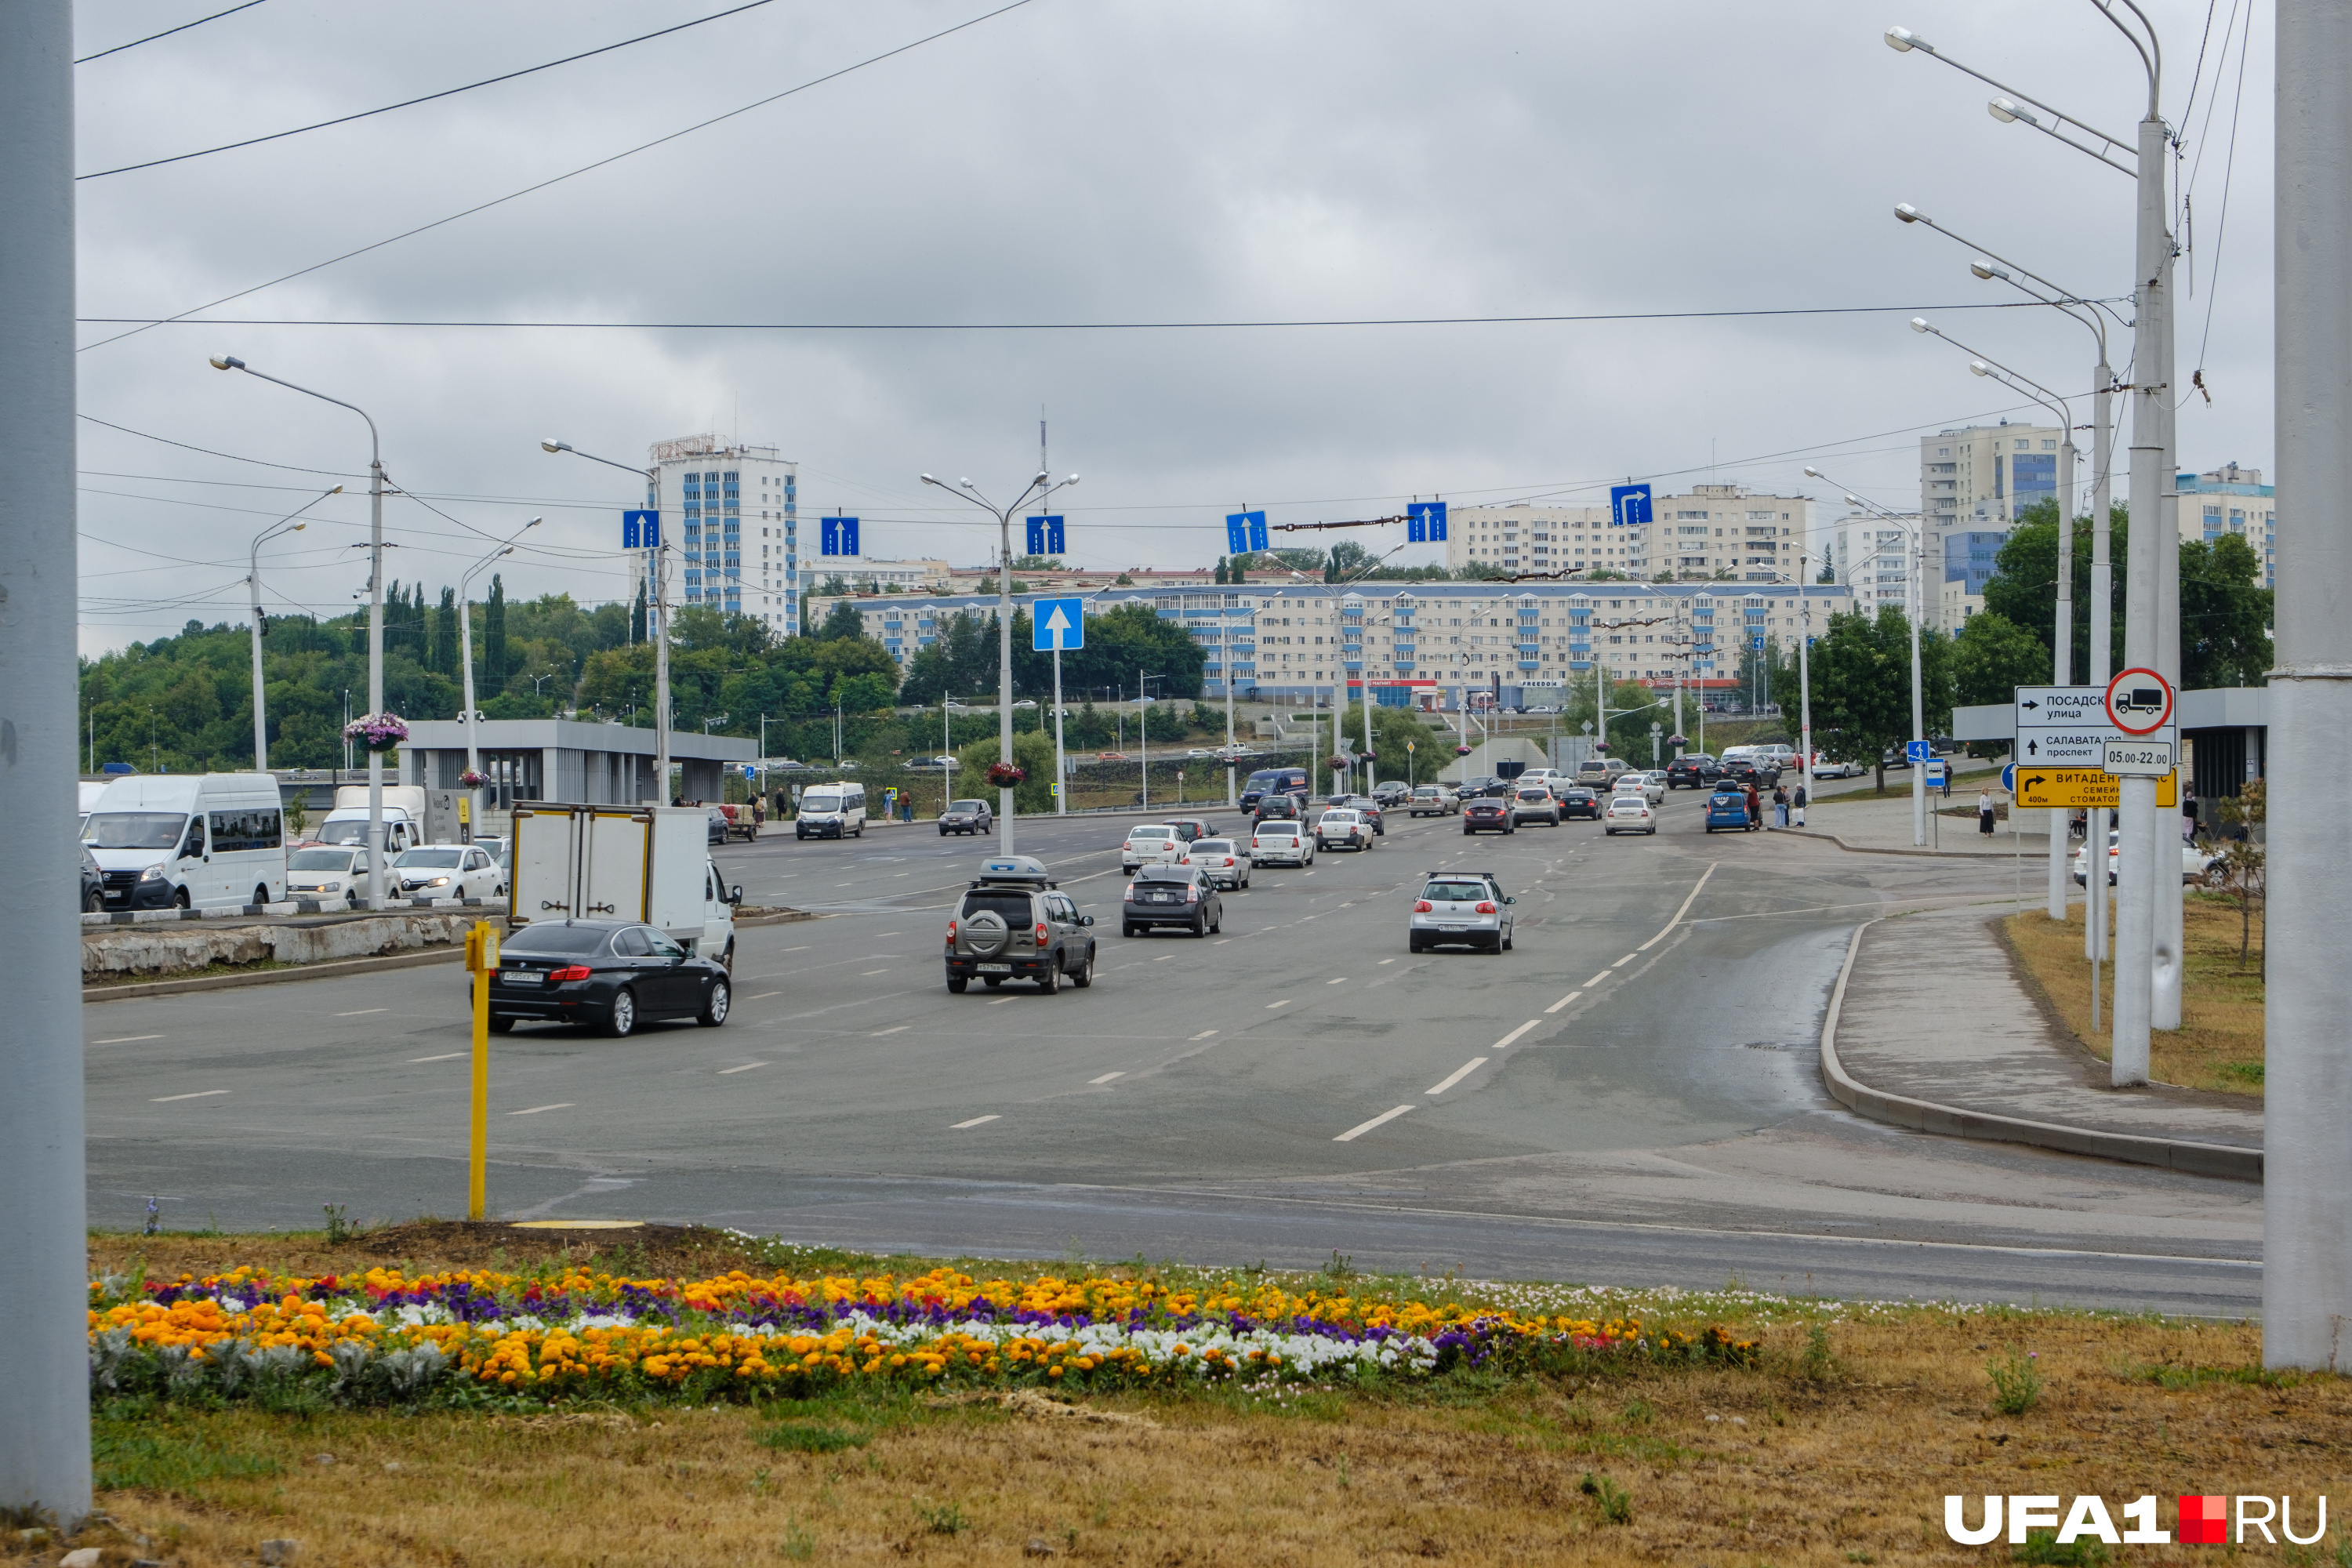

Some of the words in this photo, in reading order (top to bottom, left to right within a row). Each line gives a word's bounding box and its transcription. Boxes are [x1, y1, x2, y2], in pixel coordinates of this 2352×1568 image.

[2046, 696, 2105, 707] ПОСАДСК
[2046, 710, 2082, 720] улица
[2045, 736, 2102, 745] САЛАВАТА
[2046, 749, 2092, 758] проспект
